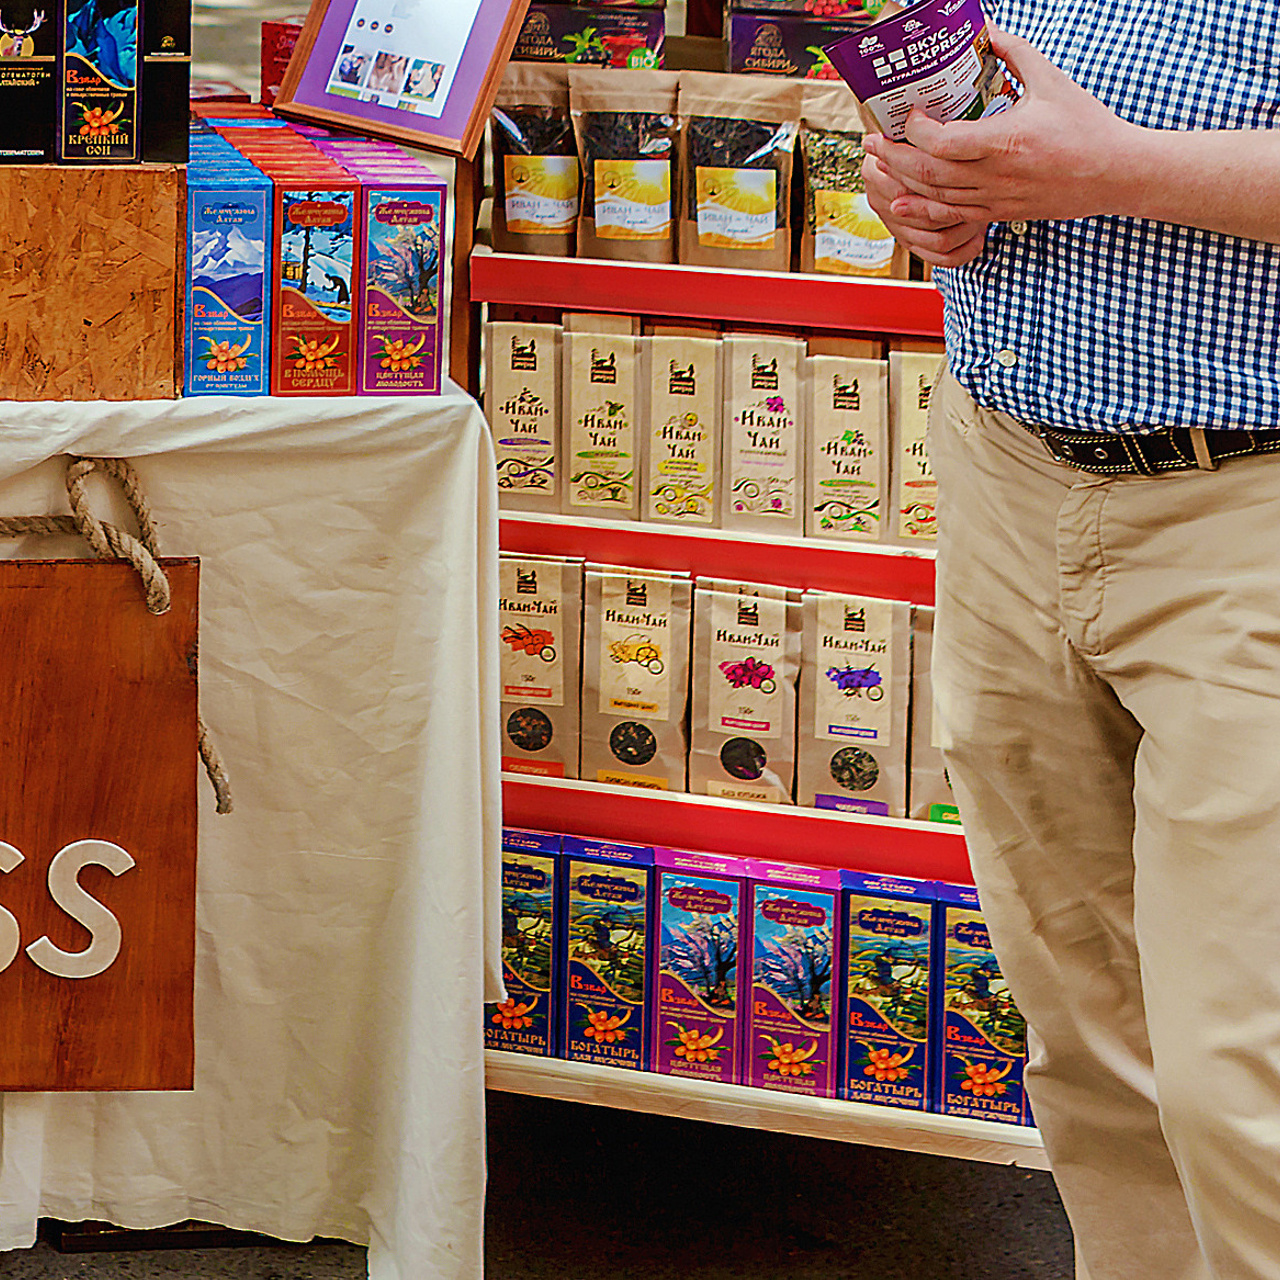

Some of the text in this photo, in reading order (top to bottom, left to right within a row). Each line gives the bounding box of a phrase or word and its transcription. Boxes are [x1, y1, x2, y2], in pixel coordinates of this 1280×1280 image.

[859, 43, 885, 56] 100%
[907, 27, 949, 55] ВКУС
[911, 20, 972, 66] EXPRESS
[66, 69, 102, 85] Взвар
[880, 60, 939, 86] НАТУРАЛЬНЫЕ
[68, 133, 129, 145] КРЕПКИЙ
[86, 145, 111, 156] СОН
[570, 1040, 639, 1060] БОГАТЫРЬ
[850, 1078, 923, 1098] БОГАТЫРЬ
[946, 1093, 1021, 1113] БОГАТЫРЬ
